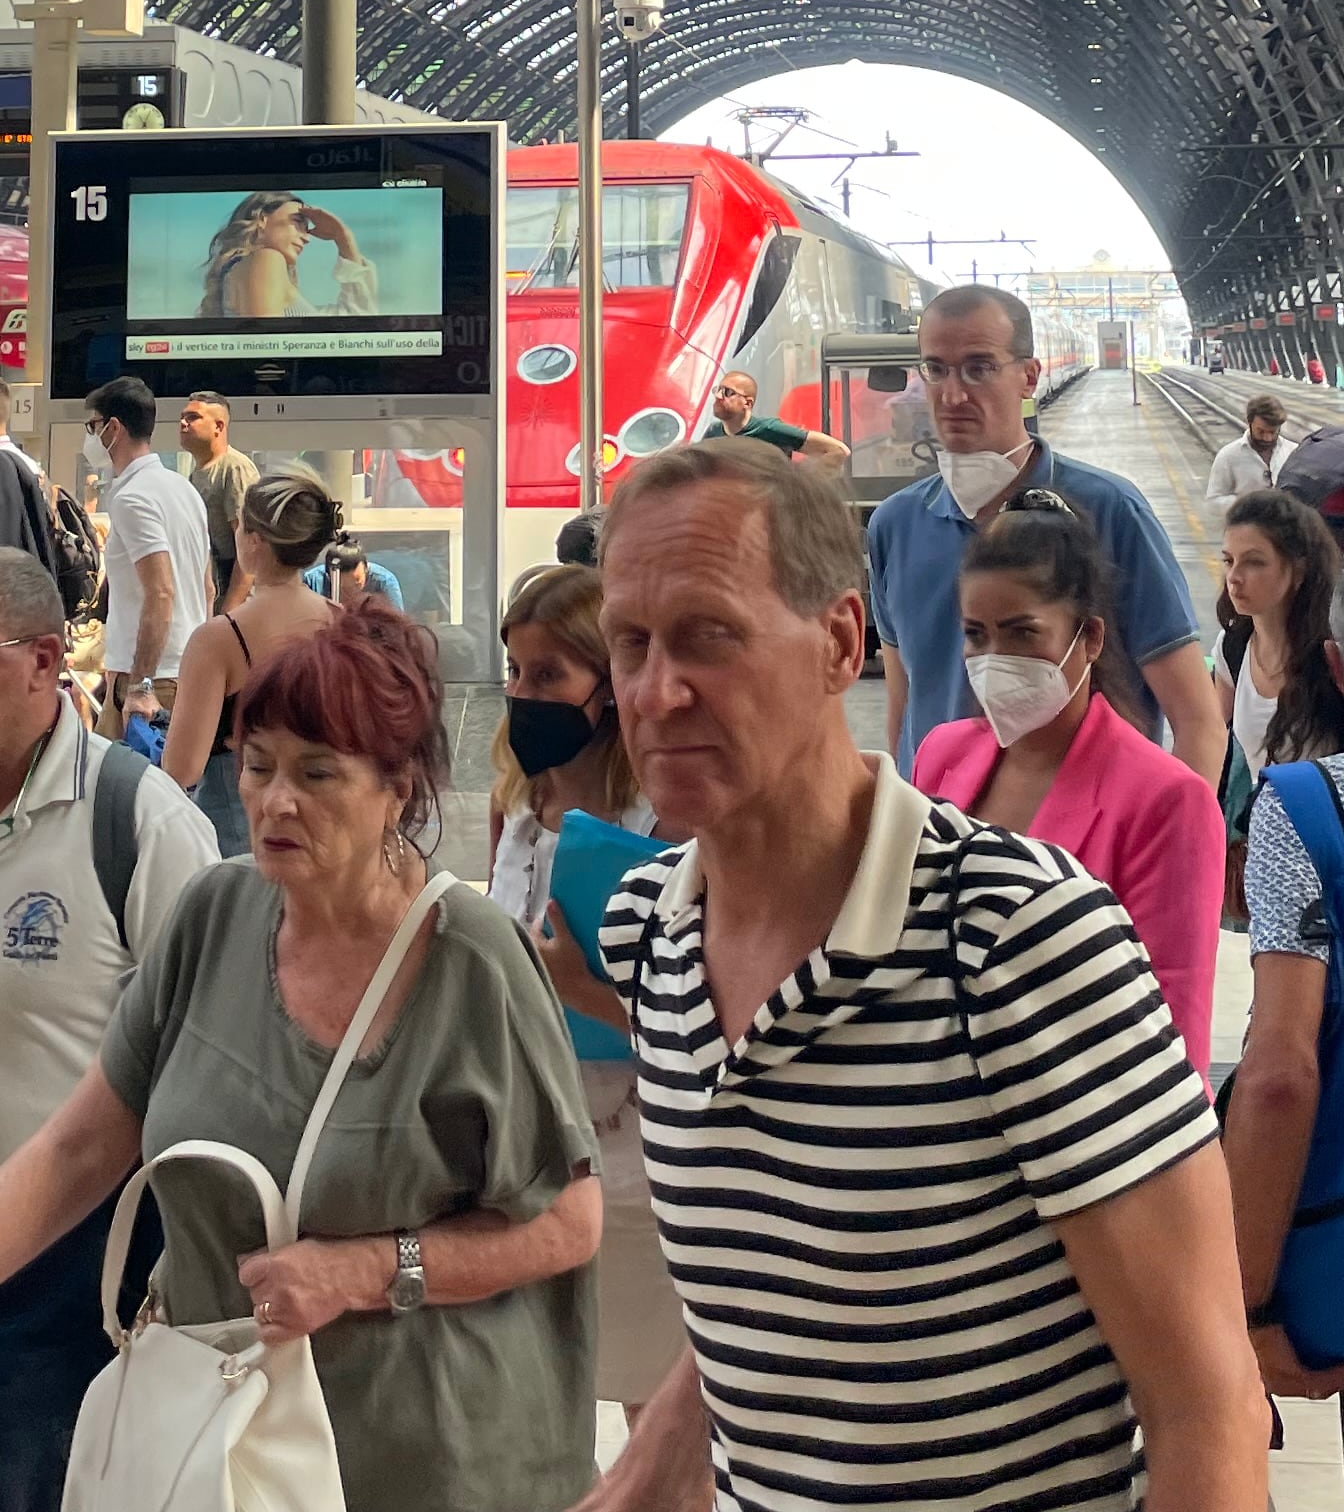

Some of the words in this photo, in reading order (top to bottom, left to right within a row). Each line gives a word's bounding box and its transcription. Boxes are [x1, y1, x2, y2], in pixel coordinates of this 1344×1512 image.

[138, 75, 157, 96] 15
[70, 185, 107, 221] 15
[128, 343, 144, 353] sky
[185, 342, 219, 351] vertice
[221, 342, 235, 350] tra
[243, 341, 280, 350] ministri
[282, 340, 326, 352] Speranza
[338, 339, 374, 349] Bianchi
[376, 339, 414, 348] sull'uso
[415, 338, 440, 348] della
[14, 400, 32, 414] 15
[3, 927, 18, 947] 5
[19, 927, 60, 948] Terre
